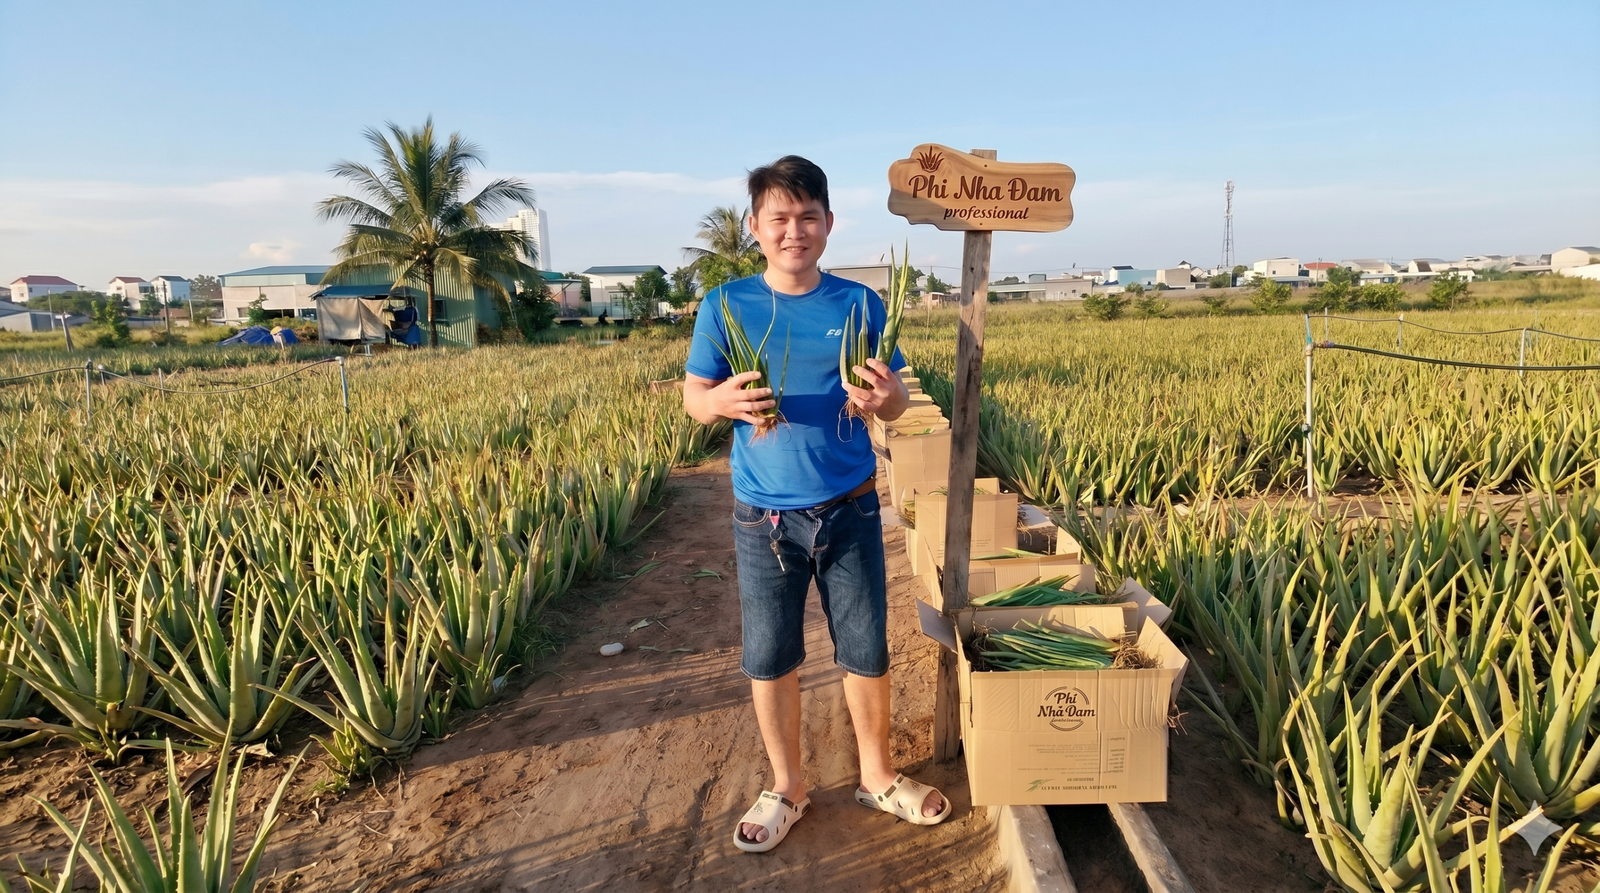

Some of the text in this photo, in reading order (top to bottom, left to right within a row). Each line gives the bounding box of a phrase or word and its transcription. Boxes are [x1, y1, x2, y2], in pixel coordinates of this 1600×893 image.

[908, 174, 1063, 202] Phi Nha Đam
[944, 206, 1029, 220] professional
